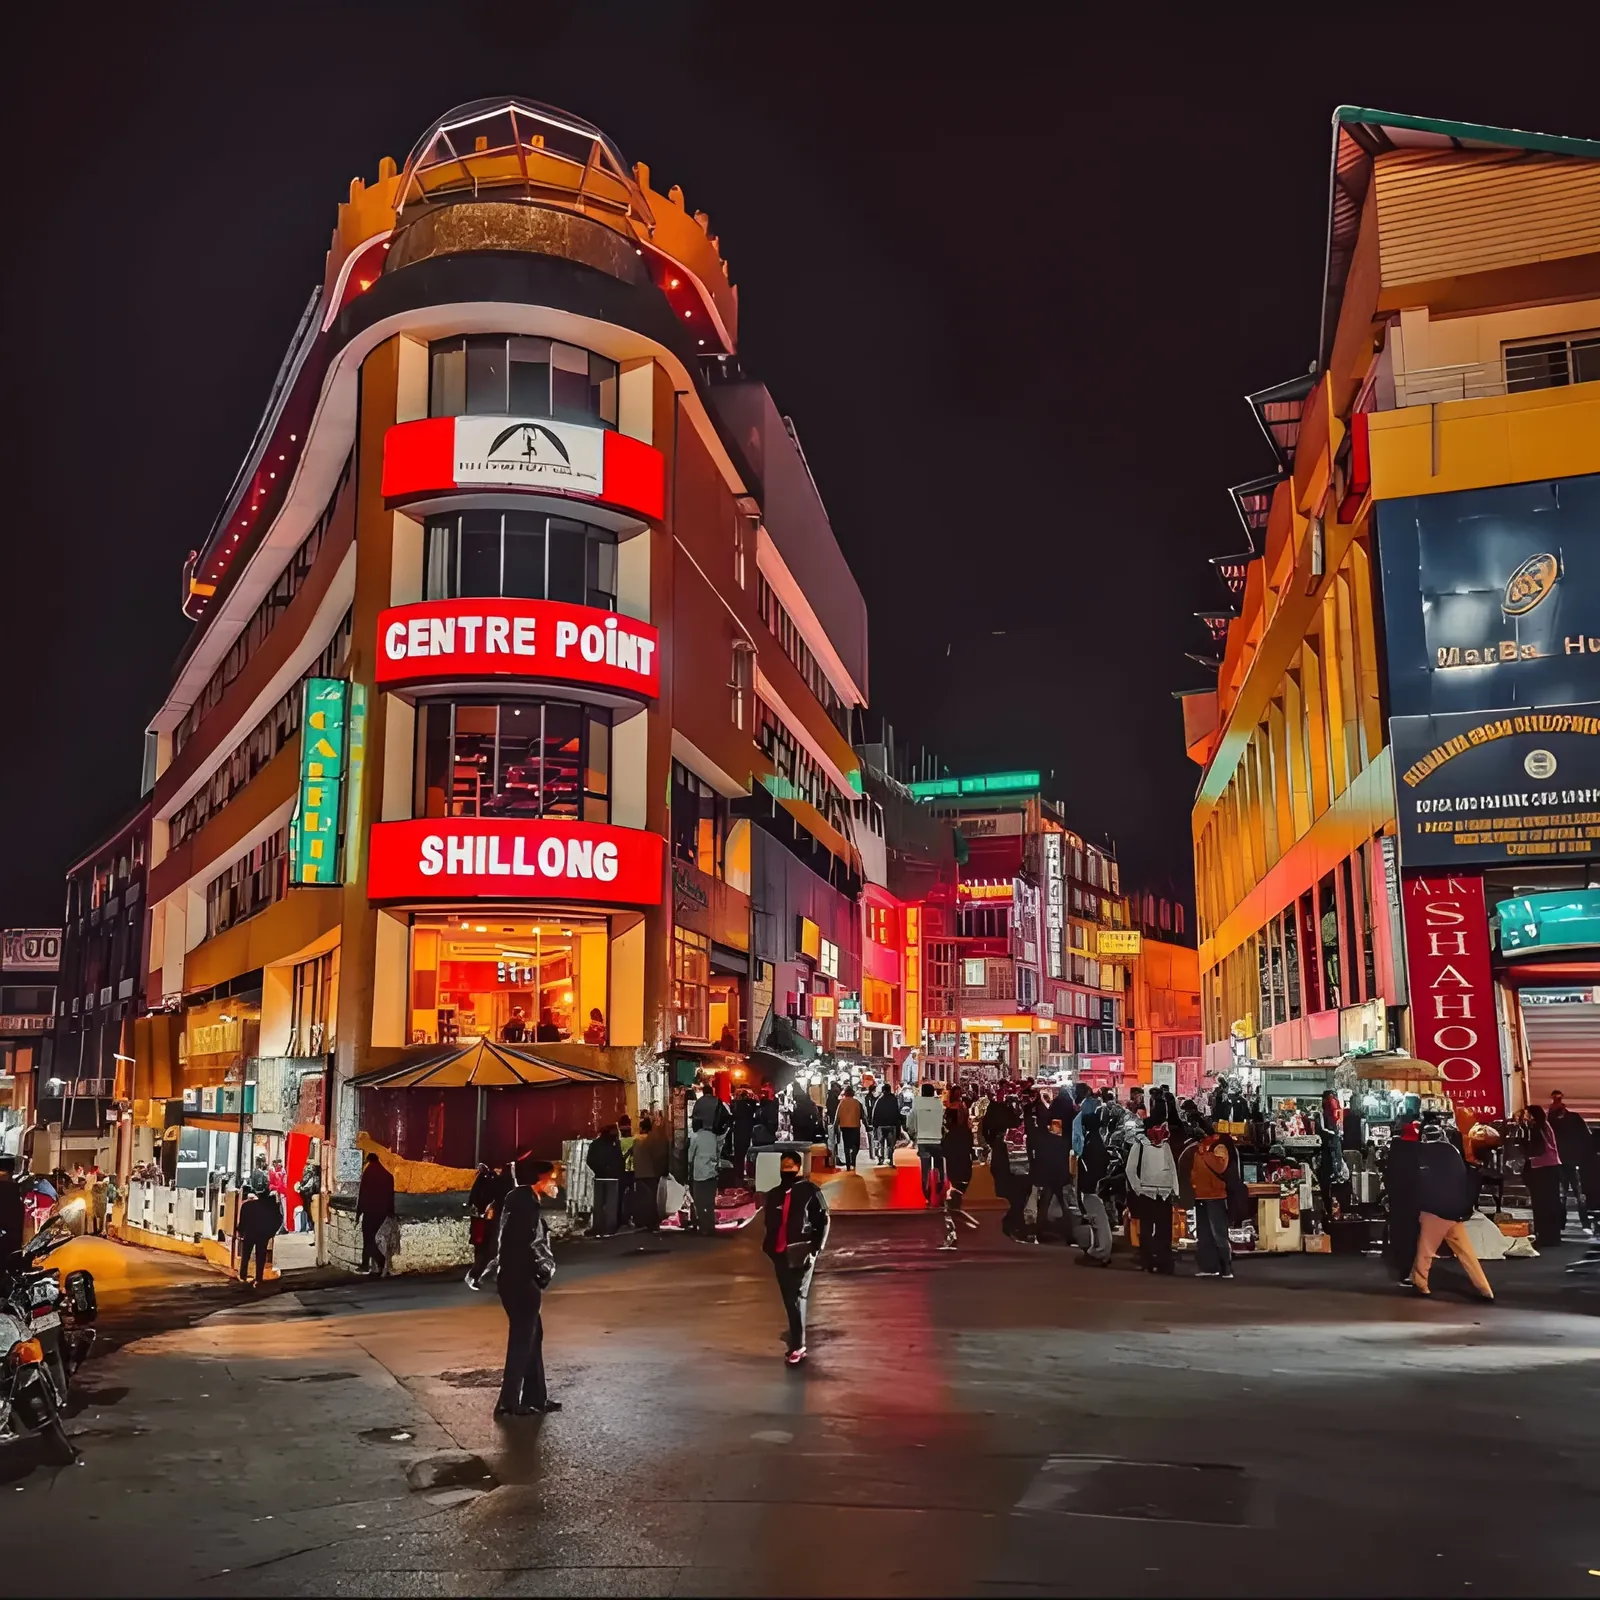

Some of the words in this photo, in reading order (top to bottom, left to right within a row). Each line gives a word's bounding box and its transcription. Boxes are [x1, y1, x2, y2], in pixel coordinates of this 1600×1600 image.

[385, 616, 536, 660] CENTRE
[418, 835, 618, 882] SHILLONG
[1424, 901, 1481, 1083] SHAHOO
